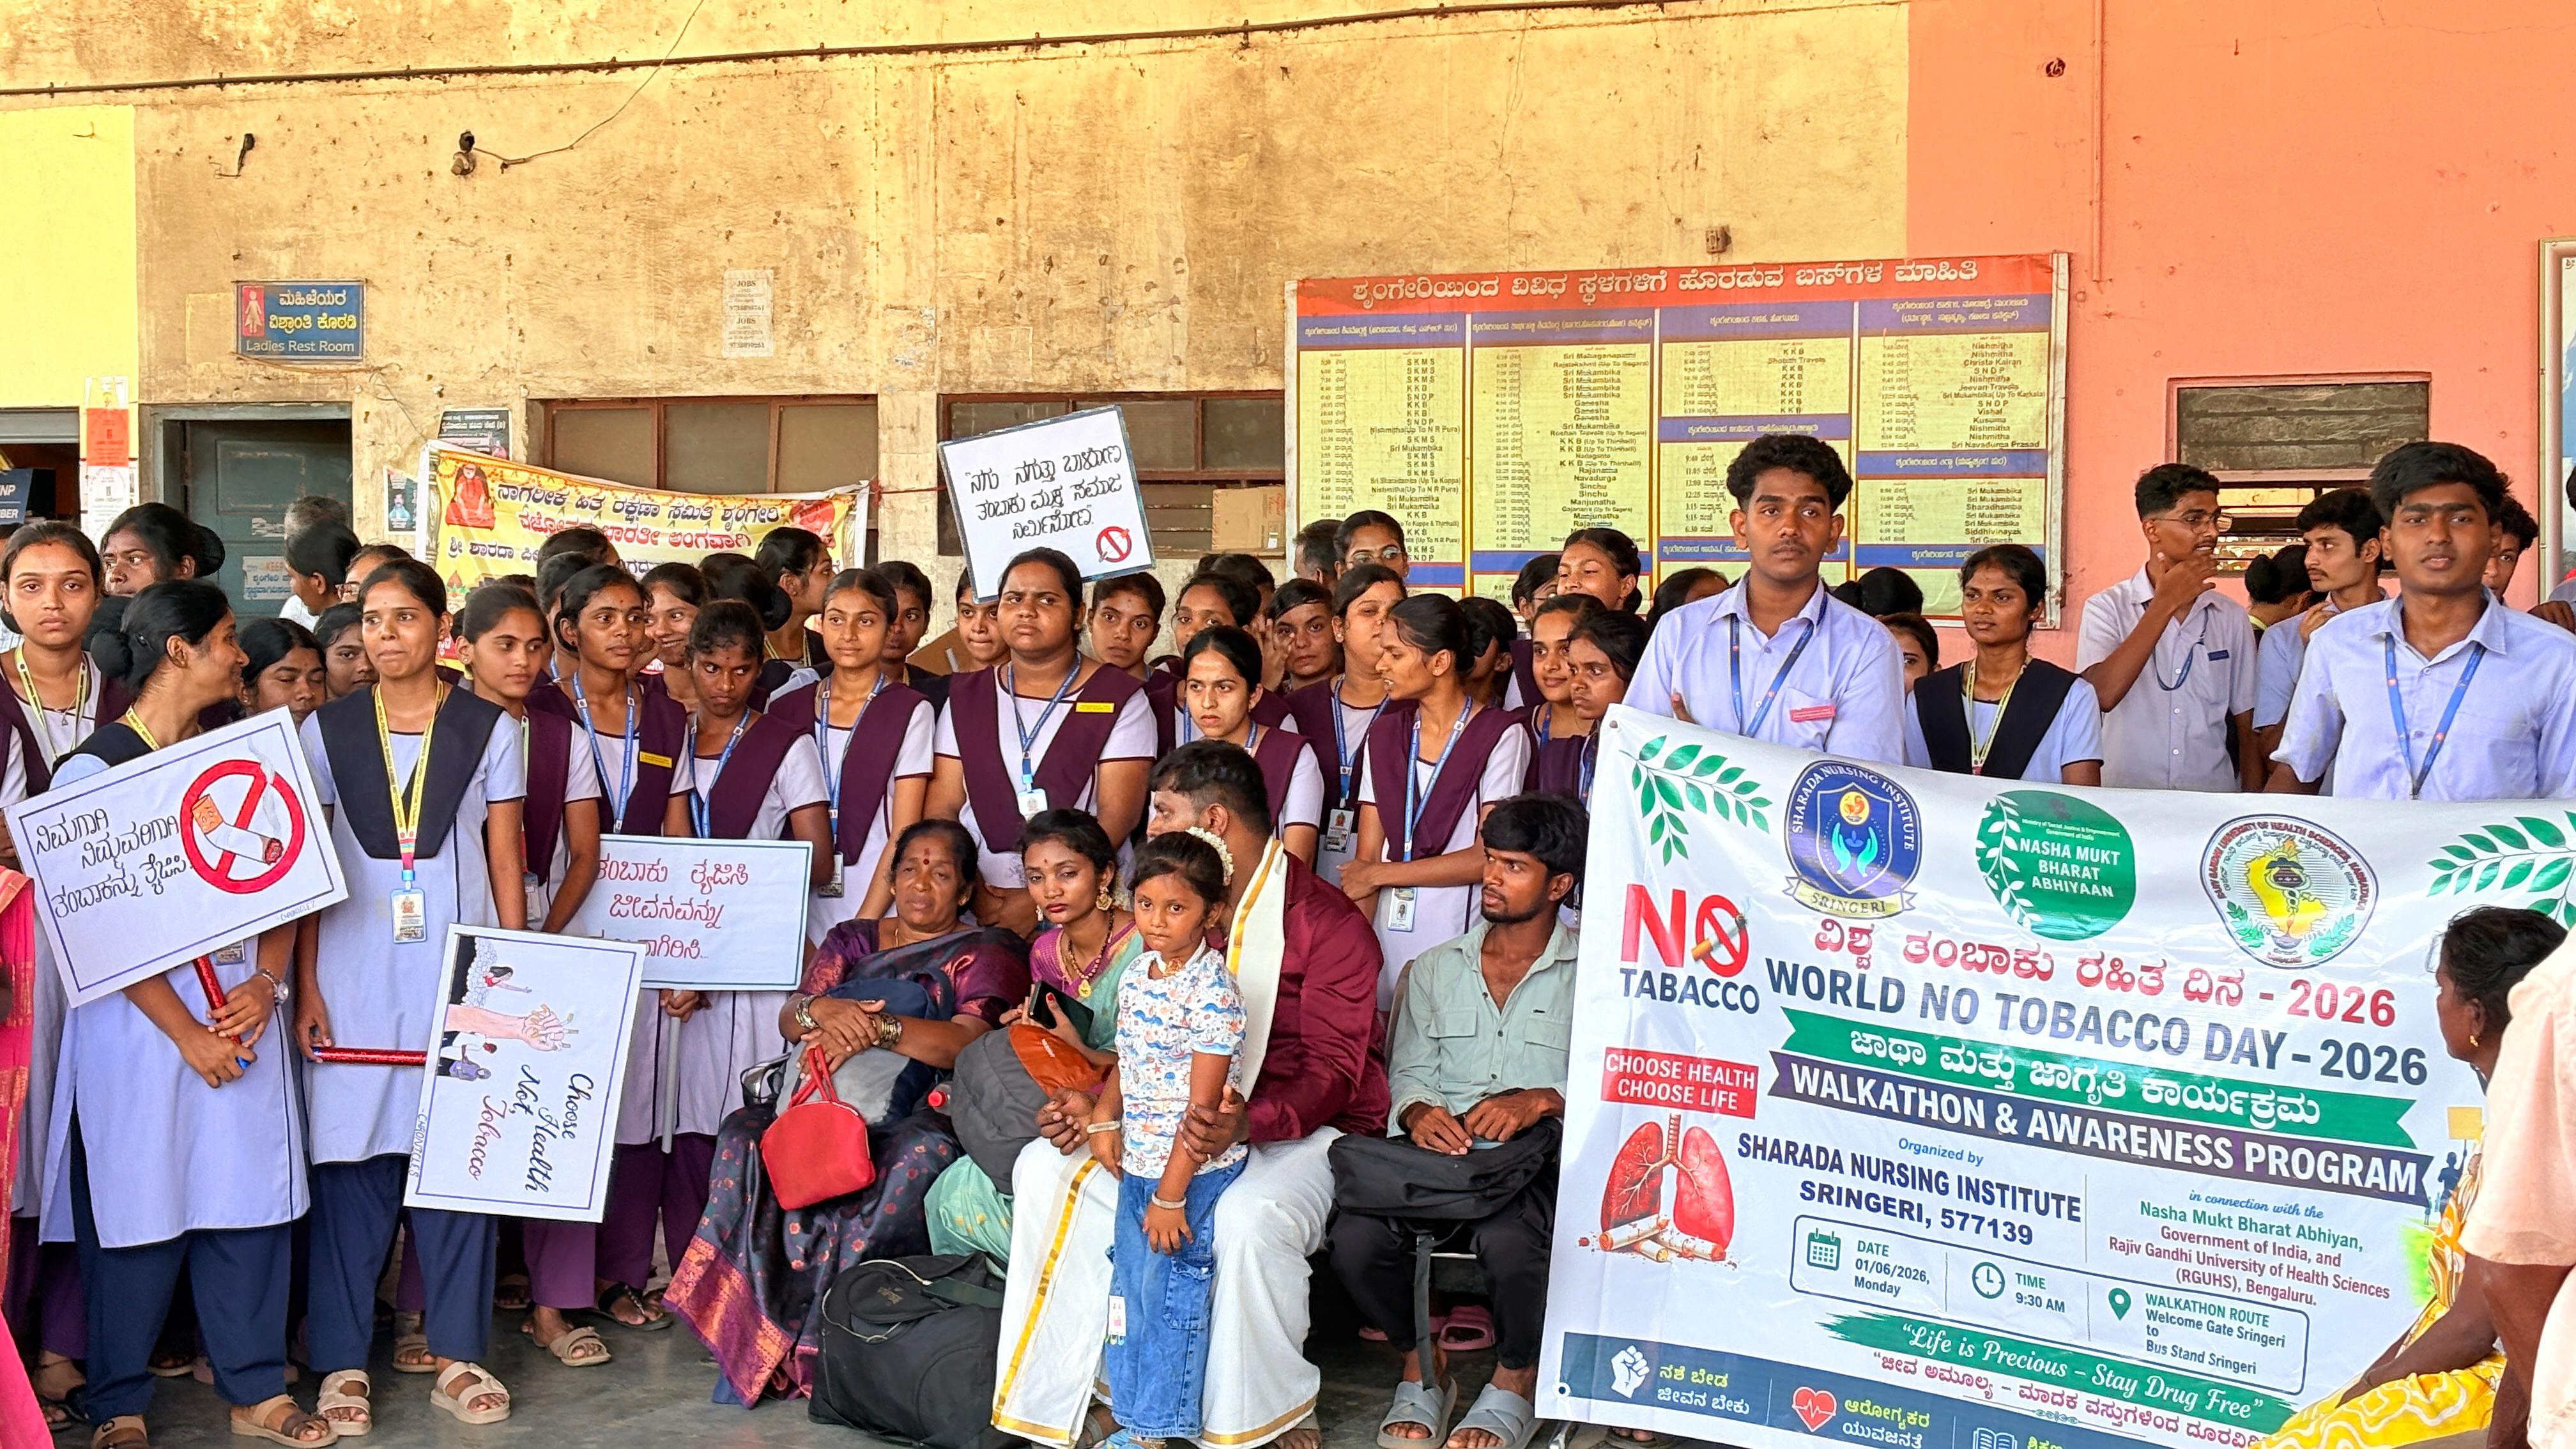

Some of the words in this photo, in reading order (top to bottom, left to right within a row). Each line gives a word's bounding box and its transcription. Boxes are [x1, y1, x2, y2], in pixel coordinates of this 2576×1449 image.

[279, 289, 346, 306] ಮಹಿಳೆಯರ
[1353, 275, 1499, 309] ಶೃಂಗೇರಿಯಿಂದ
[1512, 273, 1568, 300] ವಿವಿಧ
[1578, 269, 1667, 305] ಸ್ಥಳಗಳಿಗೆ
[1678, 264, 1785, 291] ಹೊರಡುವ
[1894, 259, 1979, 282] ಮಾಹಿತಿ
[269, 314, 312, 334] ವಿಶ್ರಾಂತಿ
[318, 312, 356, 329] ಕೊಠಡಿ
[246, 341, 285, 351] Ladies
[289, 341, 316, 351] Rest
[319, 341, 354, 351] Room
[497, 484, 569, 506] ನಾಗರೀಕ
[575, 494, 605, 511] ಹಿತ
[612, 496, 661, 522] ರಕ್ಷಣಾ
[668, 504, 714, 521] ಸಮಿತಿ
[975, 493, 1025, 521] ತಂಬಾಕು
[469, 541, 514, 559] ಶಾರದಾ
[668, 530, 752, 549] ಅಂಗವಾಗಿ
[1792, 772, 1824, 833] SHARADA
[1820, 765, 1878, 784] NURSING
[1881, 781, 1915, 851] INSTITUTE
[2020, 838, 2071, 859] NASHA
[2076, 846, 2120, 865] MUKT
[2032, 876, 2113, 897] ABHIYAAN
[2039, 859, 2100, 880] BHARAT
[1811, 893, 1885, 914] SRINGERI
[1814, 918, 1875, 970] ವಿಶ್ವ
[1903, 930, 2055, 982] ತಂಬಾಕು
[2075, 950, 2168, 996] ರಹಿತ
[2182, 967, 2244, 1007] ದಿನ
[2287, 978, 2396, 1028] 2026
[1620, 967, 1760, 1015] TABACCO
[1765, 957, 1906, 1015] WORLD
[1919, 982, 1980, 1025] NO
[1994, 992, 2191, 1056] TOBACCO
[1605, 1053, 1683, 1080] CHOOSE
[1687, 1064, 1755, 1090] HEALTH
[1850, 1030, 1928, 1067] ಜಾಥಾ
[1940, 1041, 2016, 1092] ಮತ್ತು
[2029, 1057, 2128, 1105] ಜಾಗೃತಿ
[2141, 1076, 2322, 1130] ಕಾರ್ಯಕ್ರಮ
[561, 1073, 595, 1140] Choose
[1618, 1078, 1696, 1104] CHOOSE
[1700, 1089, 1738, 1110] LIFE
[467, 1095, 507, 1181] Tobacco
[1790, 1062, 1986, 1130] WALKATHON
[1994, 1103, 2018, 1135] &
[2026, 1108, 2234, 1170] AWARENESS
[2244, 1140, 2418, 1196] PROGRAM
[525, 1107, 560, 1193] Health
[1898, 1137, 1964, 1162] Organized
[1966, 1153, 1984, 1168] by
[1737, 1132, 1844, 1175] SHARADA
[1850, 1153, 1950, 1196] NURSING
[1957, 1174, 2082, 1223] INSTITUTE
[1799, 1179, 1933, 1229] SRINGERI,
[1940, 1209, 2034, 1246] 577139
[2189, 1189, 2202, 1202] in
[2205, 1192, 2269, 1214] connection
[2273, 1201, 2301, 1217] with
[2303, 1204, 2325, 1220] the
[2140, 1200, 2188, 1223] Nasha
[2192, 1209, 2234, 1230] Mukt
[2237, 1216, 2292, 1238] Bharat
[2296, 1224, 2364, 1254] Abhiyan,
[1857, 1239, 1890, 1259] DATE
[2161, 1225, 2250, 1253] Government
[2253, 1239, 2269, 1255] of
[2271, 1241, 2312, 1266] India,
[2315, 1249, 2342, 1268] and
[1855, 1257, 1931, 1286] 01/06/2026,
[2014, 1272, 2046, 1290] TIME
[2109, 1236, 2142, 1257] Rajiv
[2145, 1242, 2193, 1264] Gandhi
[2195, 1252, 2267, 1278] University
[2269, 1261, 2284, 1280] of
[2285, 1264, 2329, 1287] Health
[2332, 1273, 2391, 1300] Sciences
[1854, 1275, 1902, 1299] Monday
[2015, 1292, 2043, 1309] 9:30
[2045, 1296, 2066, 1314] AM
[2176, 1268, 2241, 1294] (RGUHS),
[2246, 1278, 2317, 1307] Bengaluru.
[2145, 1292, 2227, 1319] WALKATHON
[2230, 1307, 2270, 1329] ROUTE
[2145, 1308, 2203, 1331] Welcome
[2205, 1319, 2234, 1337] Gate
[2236, 1326, 2286, 1350] Sringeri
[2146, 1324, 2159, 1338] to
[2146, 1340, 2168, 1356] Bus
[2170, 1345, 2205, 1365] Stand
[2207, 1353, 2257, 1376] Sringeri
[1659, 1364, 1686, 1384] ನಶೆ
[1690, 1369, 1729, 1389] ಬೇಡ
[1958, 1337, 1975, 1358] is
[1981, 1340, 2069, 1378] Precious
[2091, 1362, 2139, 1400] Stay
[2145, 1375, 2200, 1414] Drug
[1657, 1387, 1707, 1407] ಜೀವನ
[1712, 1393, 1751, 1416] ಬೇಕು
[1844, 1398, 1931, 1430] ಆರೋಗ್ಯಕರ
[1924, 1365, 1994, 1400] ಅಮೂಲ್ಯ
[2018, 1383, 2078, 1410] ಮಾದಕ
[2085, 1397, 2179, 1434] ವಸ್ತುಗಳಿಂದ
[1842, 1420, 1923, 1449] ಯುವಜನತೆ
